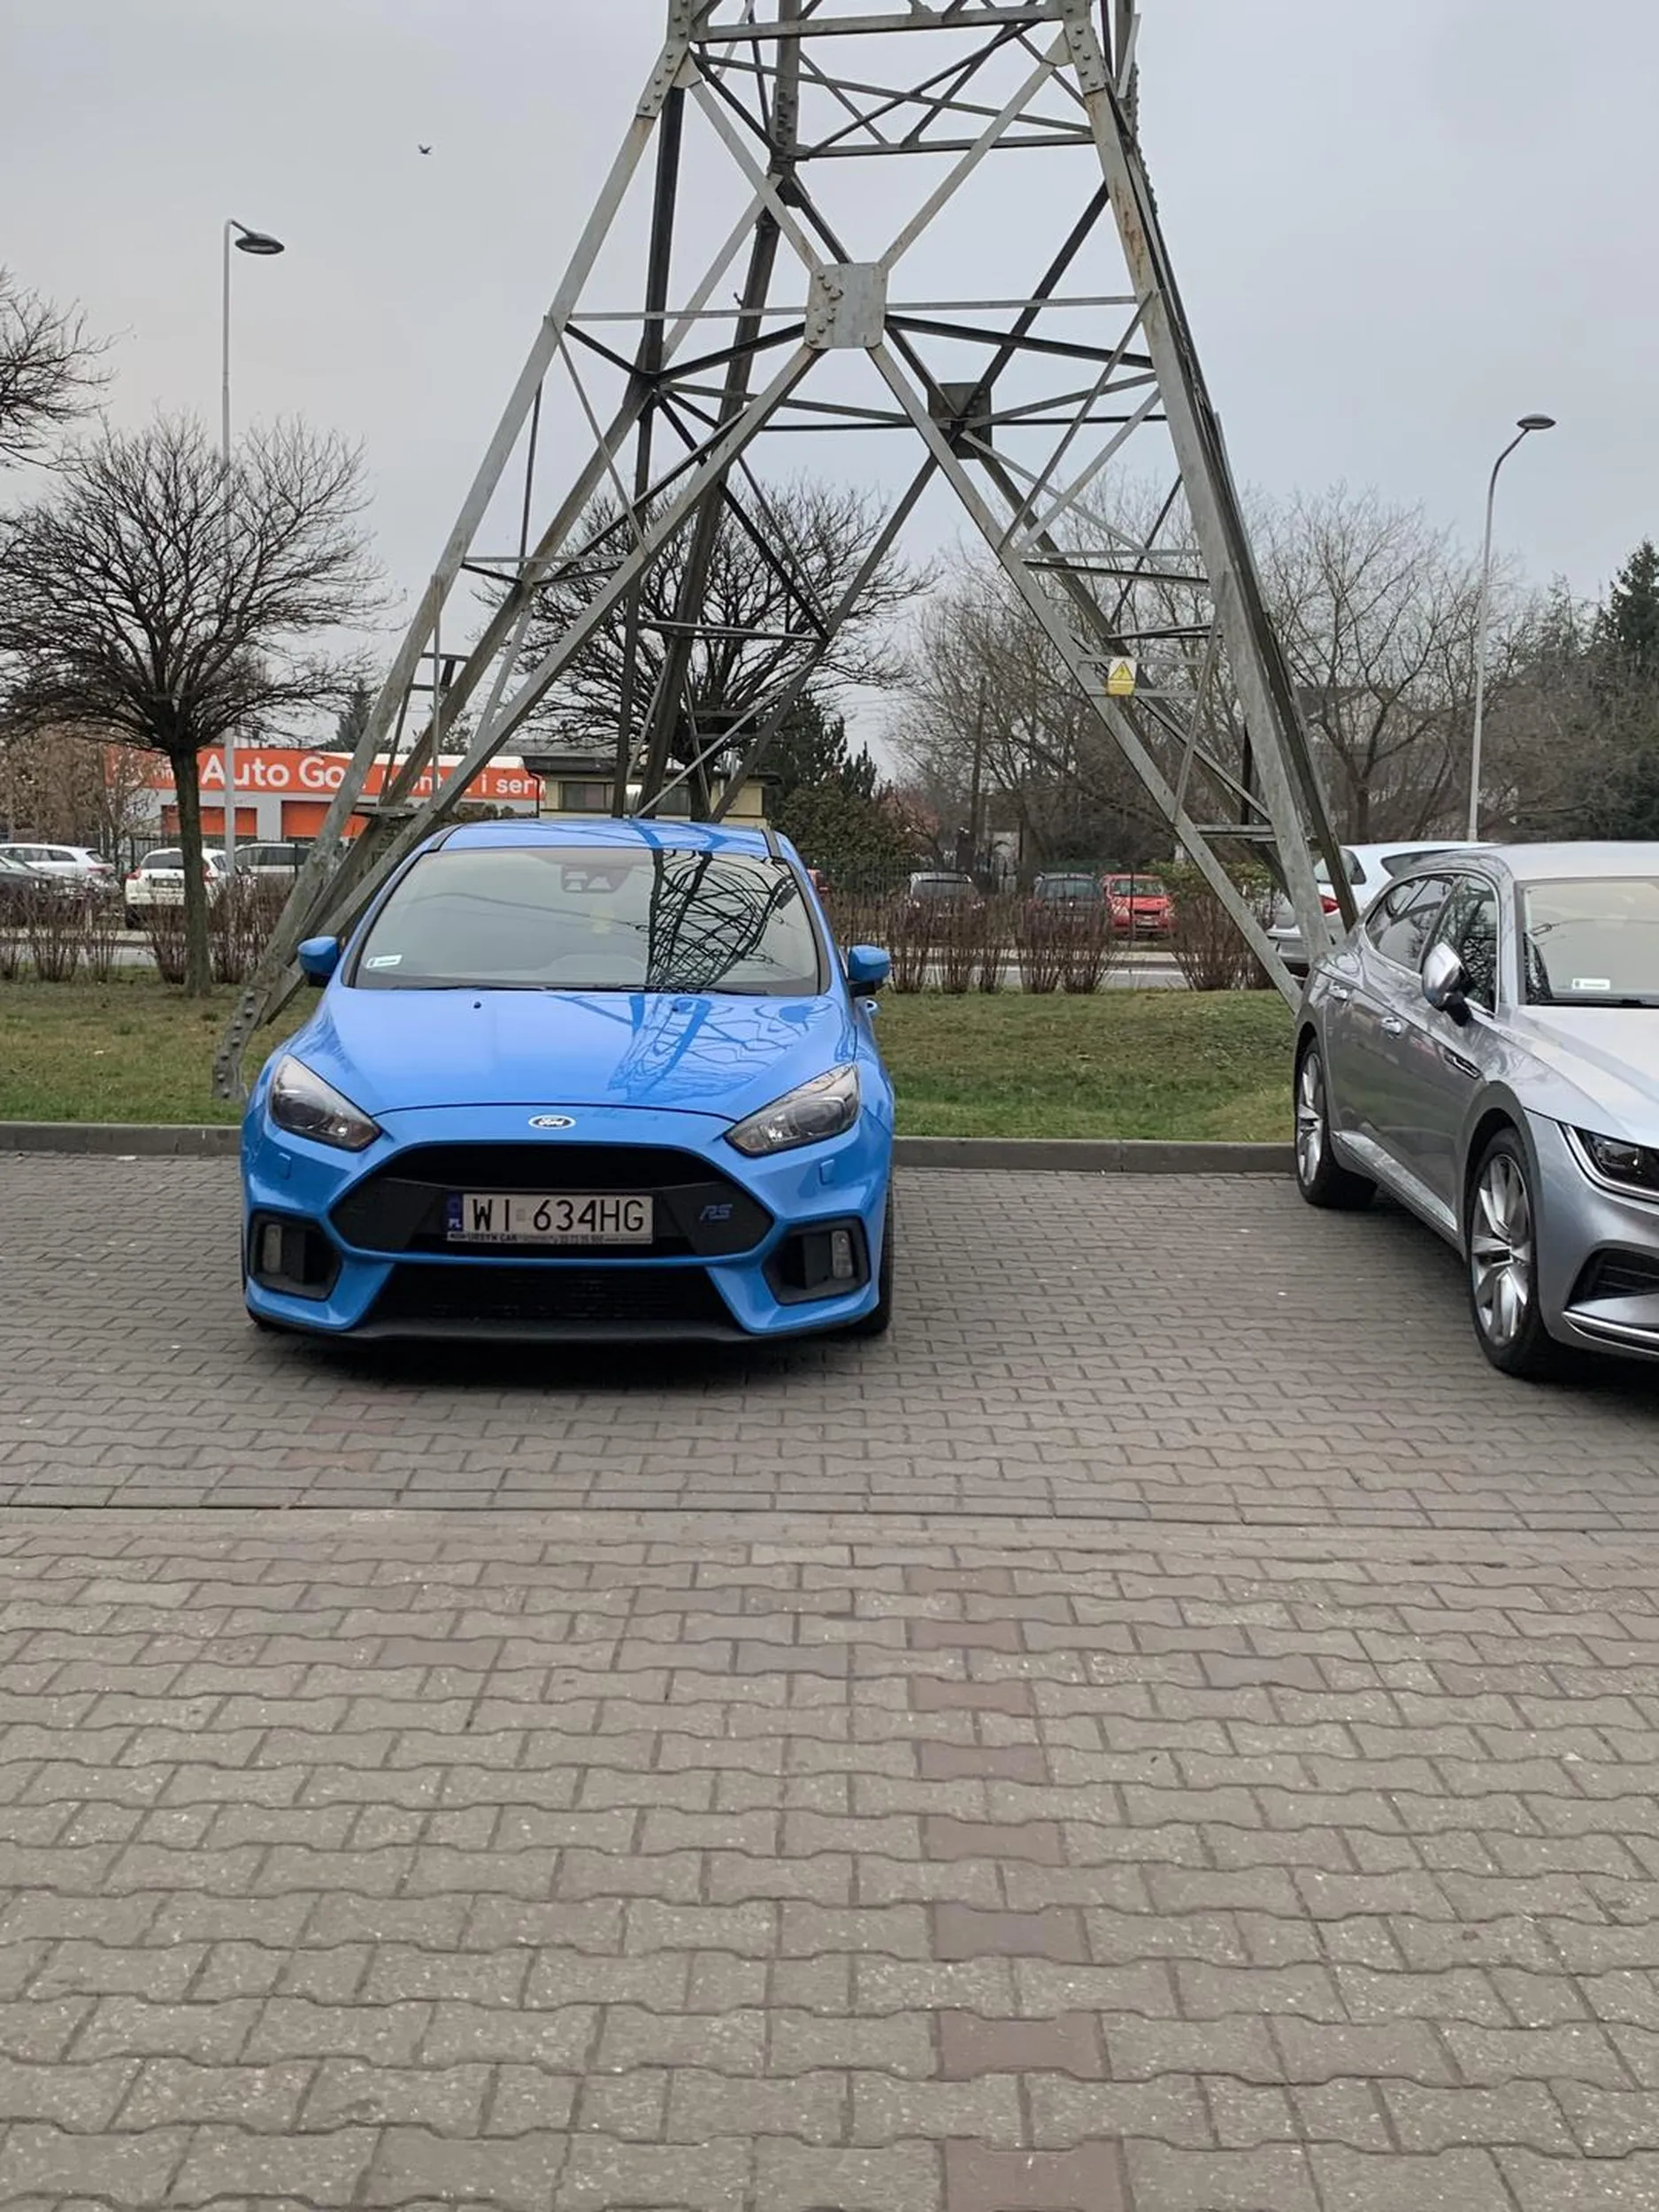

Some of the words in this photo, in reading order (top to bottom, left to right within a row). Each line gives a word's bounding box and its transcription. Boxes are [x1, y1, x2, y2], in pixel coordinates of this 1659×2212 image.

[201, 753, 290, 787] Auto
[533, 1199, 645, 1233] 634HG
[699, 1203, 733, 1221] RS
